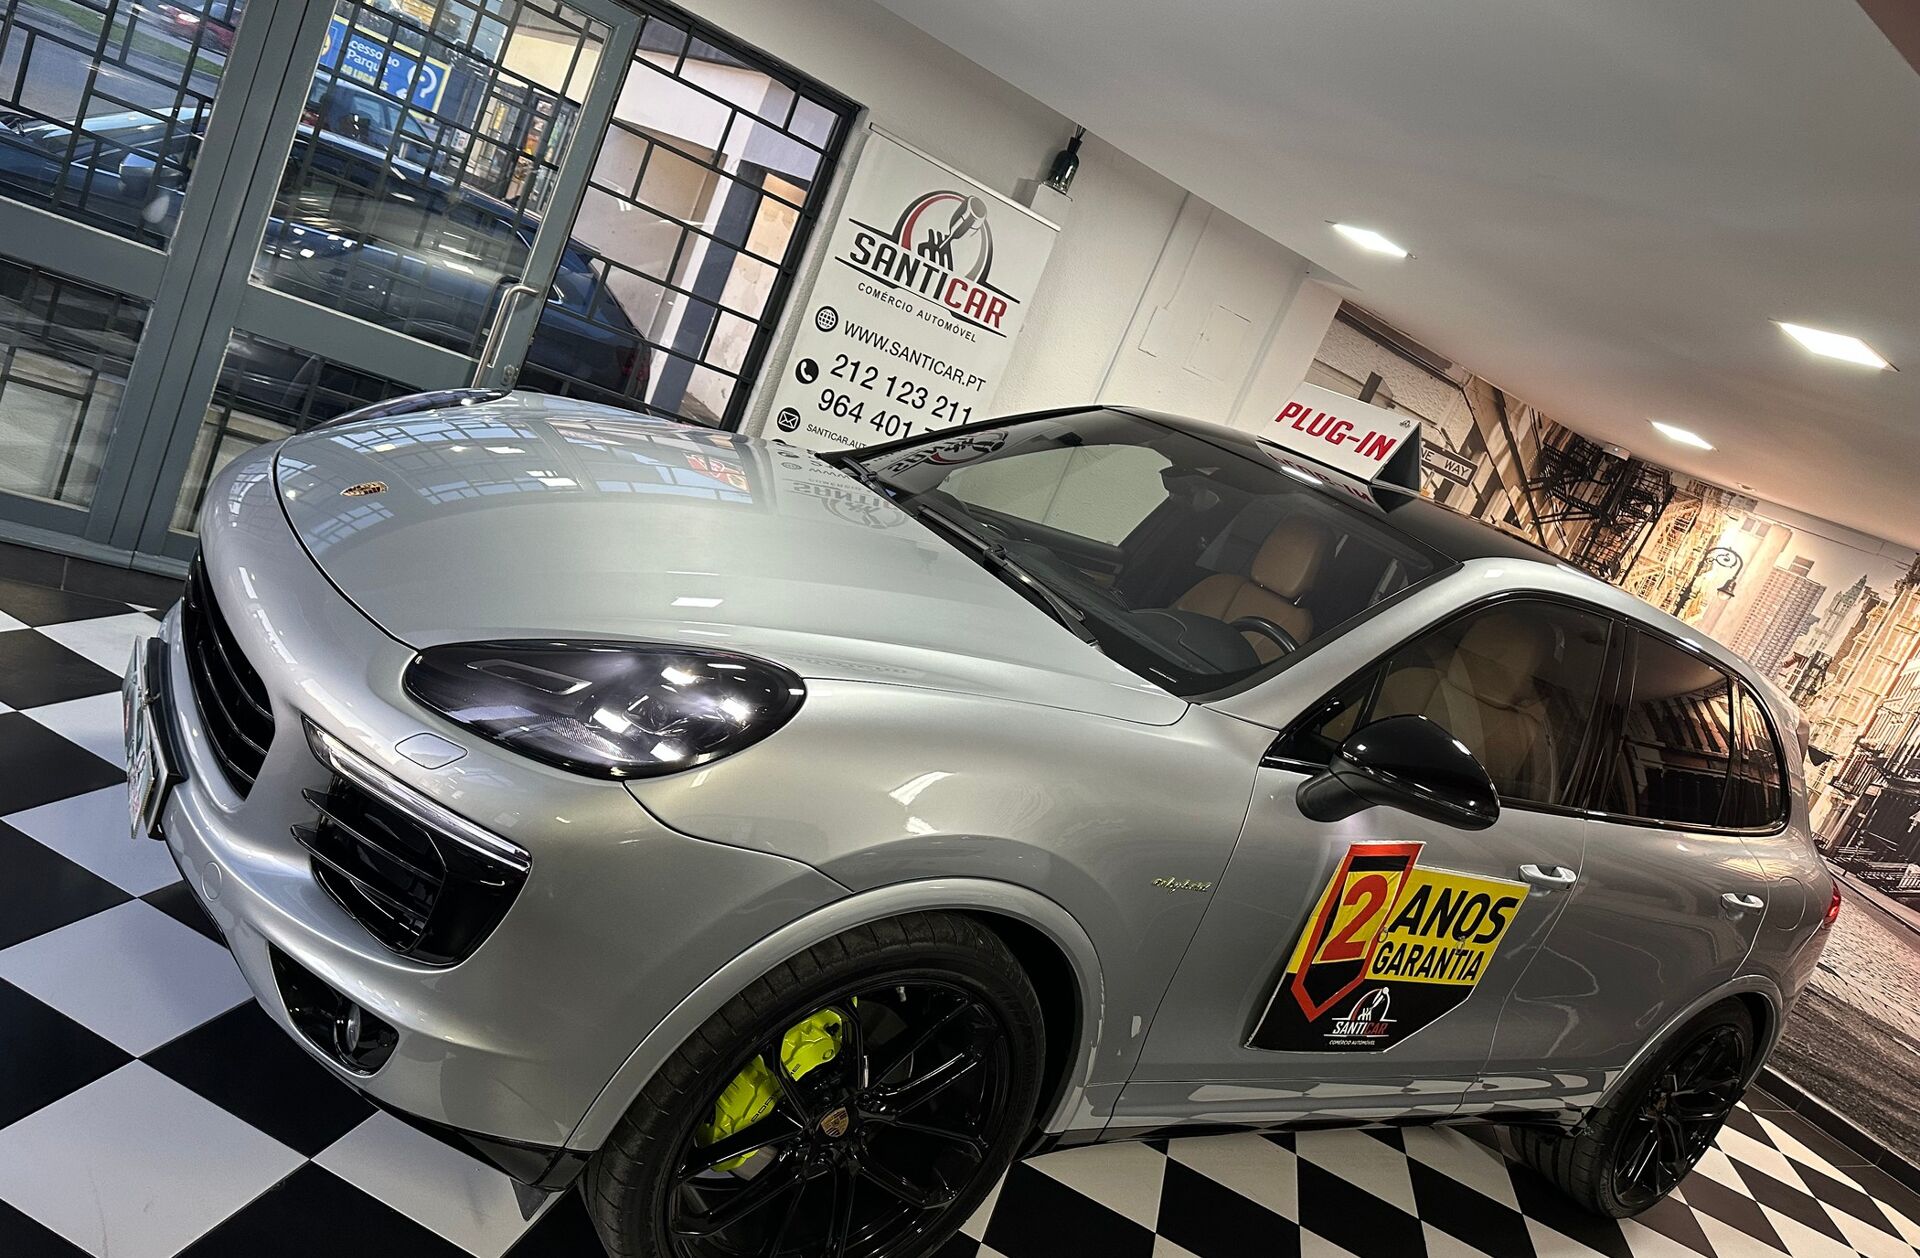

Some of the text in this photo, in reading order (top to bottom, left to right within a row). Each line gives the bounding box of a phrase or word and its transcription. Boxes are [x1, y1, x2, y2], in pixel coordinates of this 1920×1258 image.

[348, 40, 384, 60] cesso
[849, 231, 1008, 329] SANTICAR
[857, 281, 977, 343] COMÉRCIO AUTOMÓVEL
[844, 320, 987, 393] WWW.SANTICAR.PT
[817, 388, 913, 439] 964 401
[830, 353, 972, 425] 212 123 211
[1274, 401, 1397, 462] PLUG-IN
[1420, 447, 1469, 477] NE WAY
[1320, 873, 1521, 962] 2 ANOS
[1371, 941, 1485, 981] GARANTIA
[1332, 1021, 1389, 1035] SANTICAR
